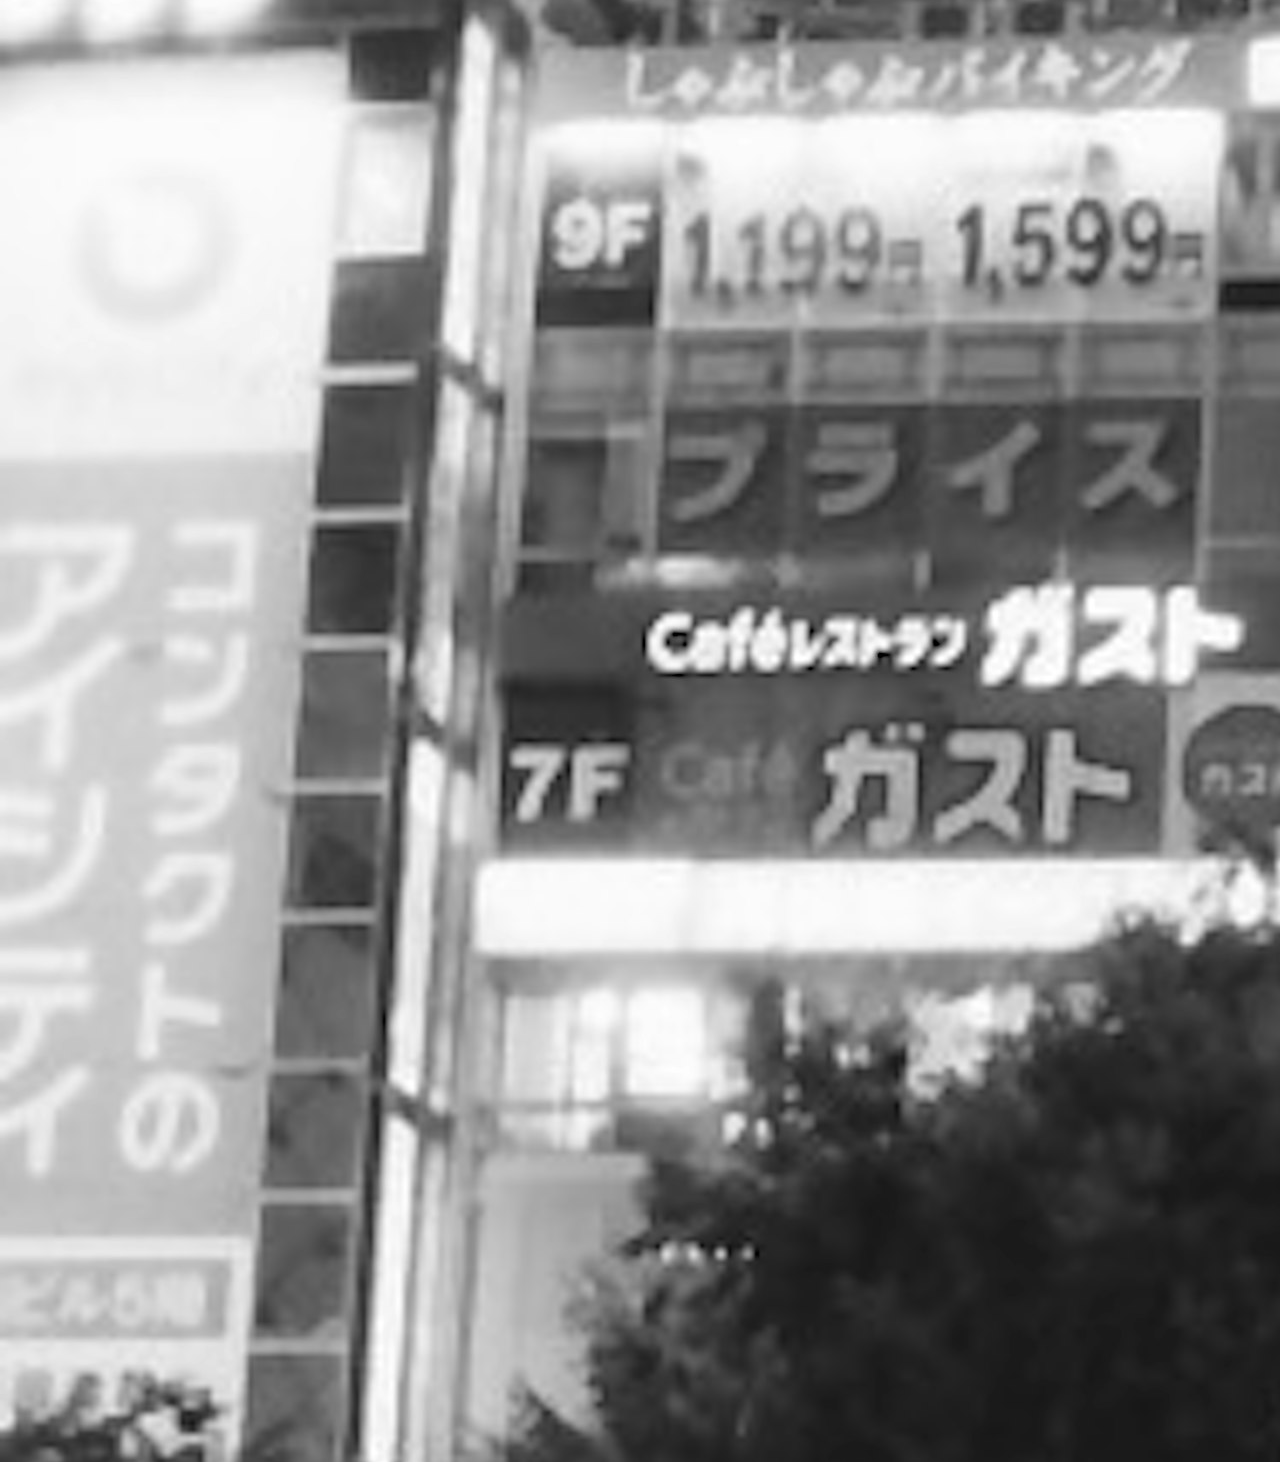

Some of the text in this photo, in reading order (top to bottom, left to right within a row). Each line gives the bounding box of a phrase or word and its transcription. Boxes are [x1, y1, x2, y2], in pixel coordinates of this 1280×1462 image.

[551, 198, 652, 270] 9F
[665, 418, 1181, 523] プライス
[980, 582, 1246, 688] ガスト
[508, 743, 631, 823] 7F
[811, 721, 1132, 852] ガスト
[119, 522, 258, 1175] コンタクトの
